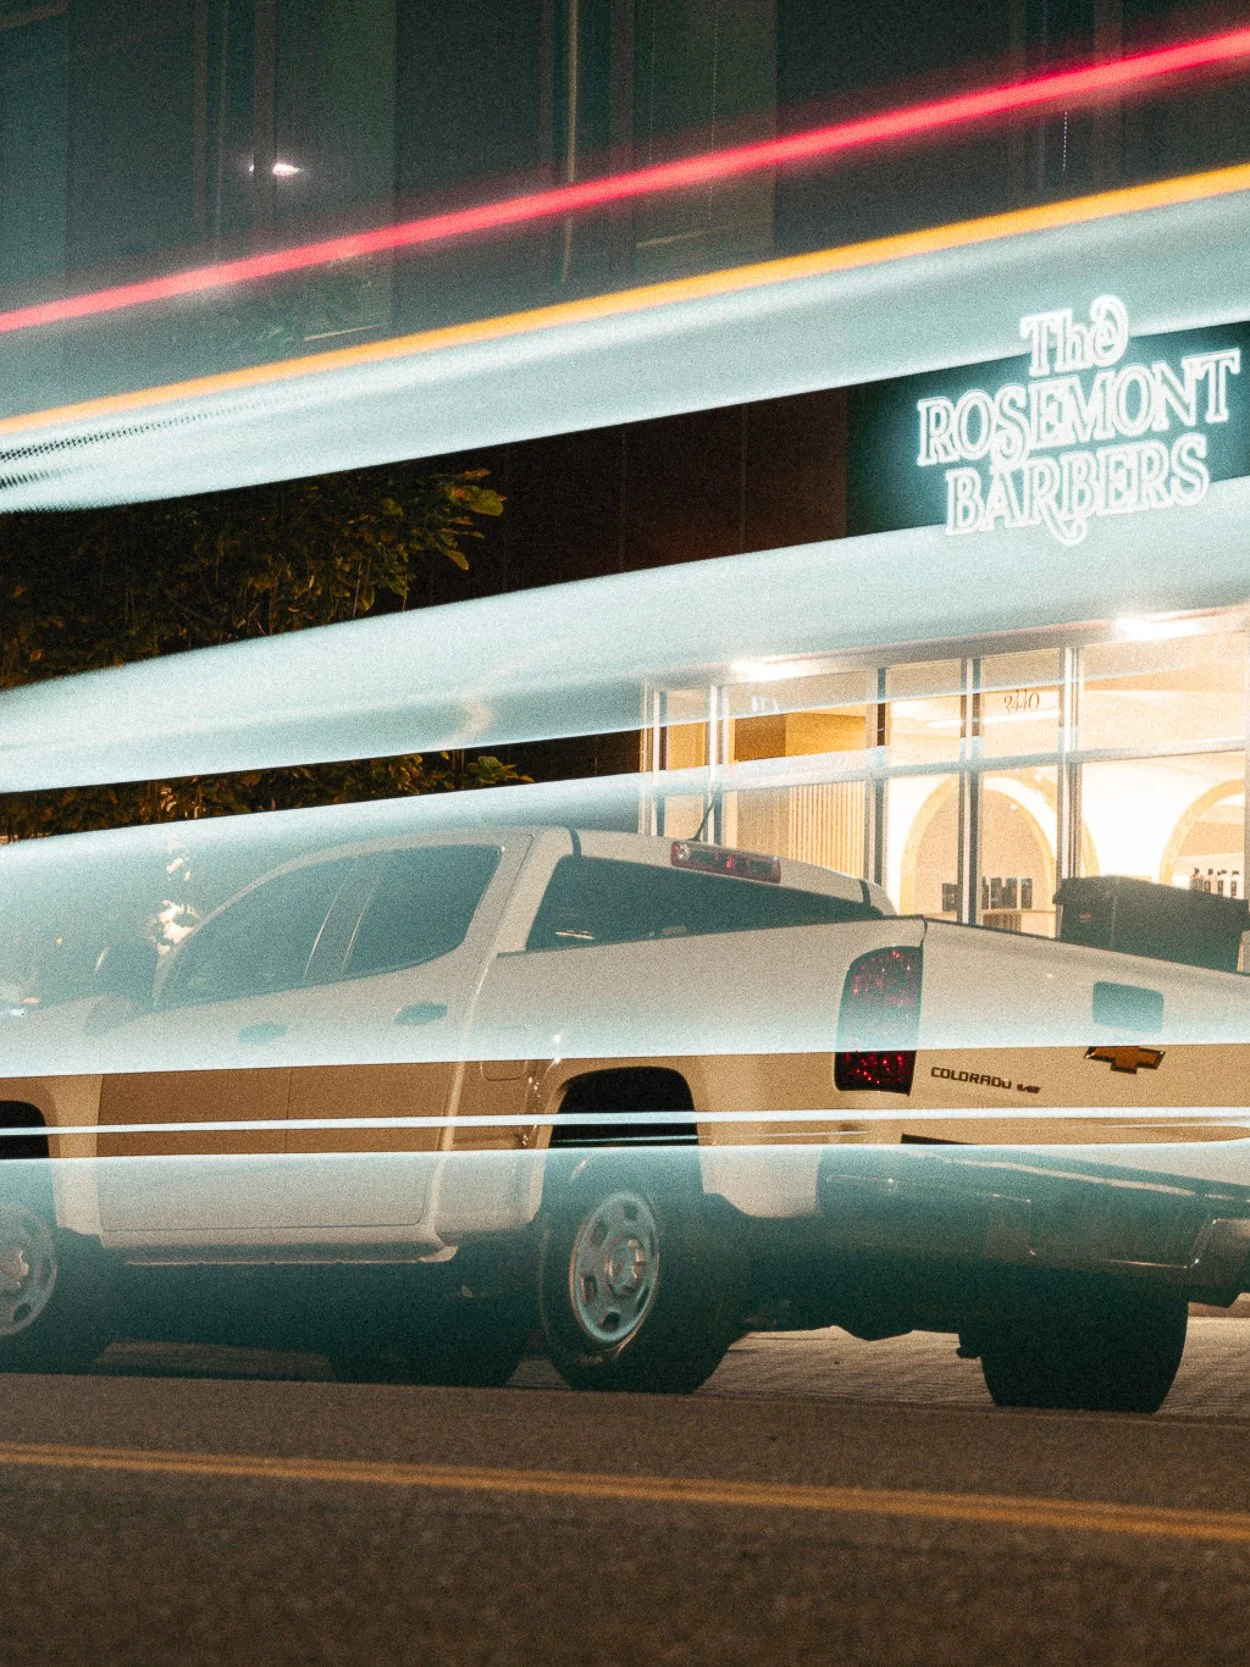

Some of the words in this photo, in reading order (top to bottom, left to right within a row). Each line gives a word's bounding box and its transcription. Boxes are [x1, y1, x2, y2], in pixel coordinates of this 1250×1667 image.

[1020, 295, 1128, 376] The
[917, 348, 1240, 468] ROSEMONT
[946, 433, 1210, 545] BARBERS
[931, 1066, 1012, 1089] COLORADO
